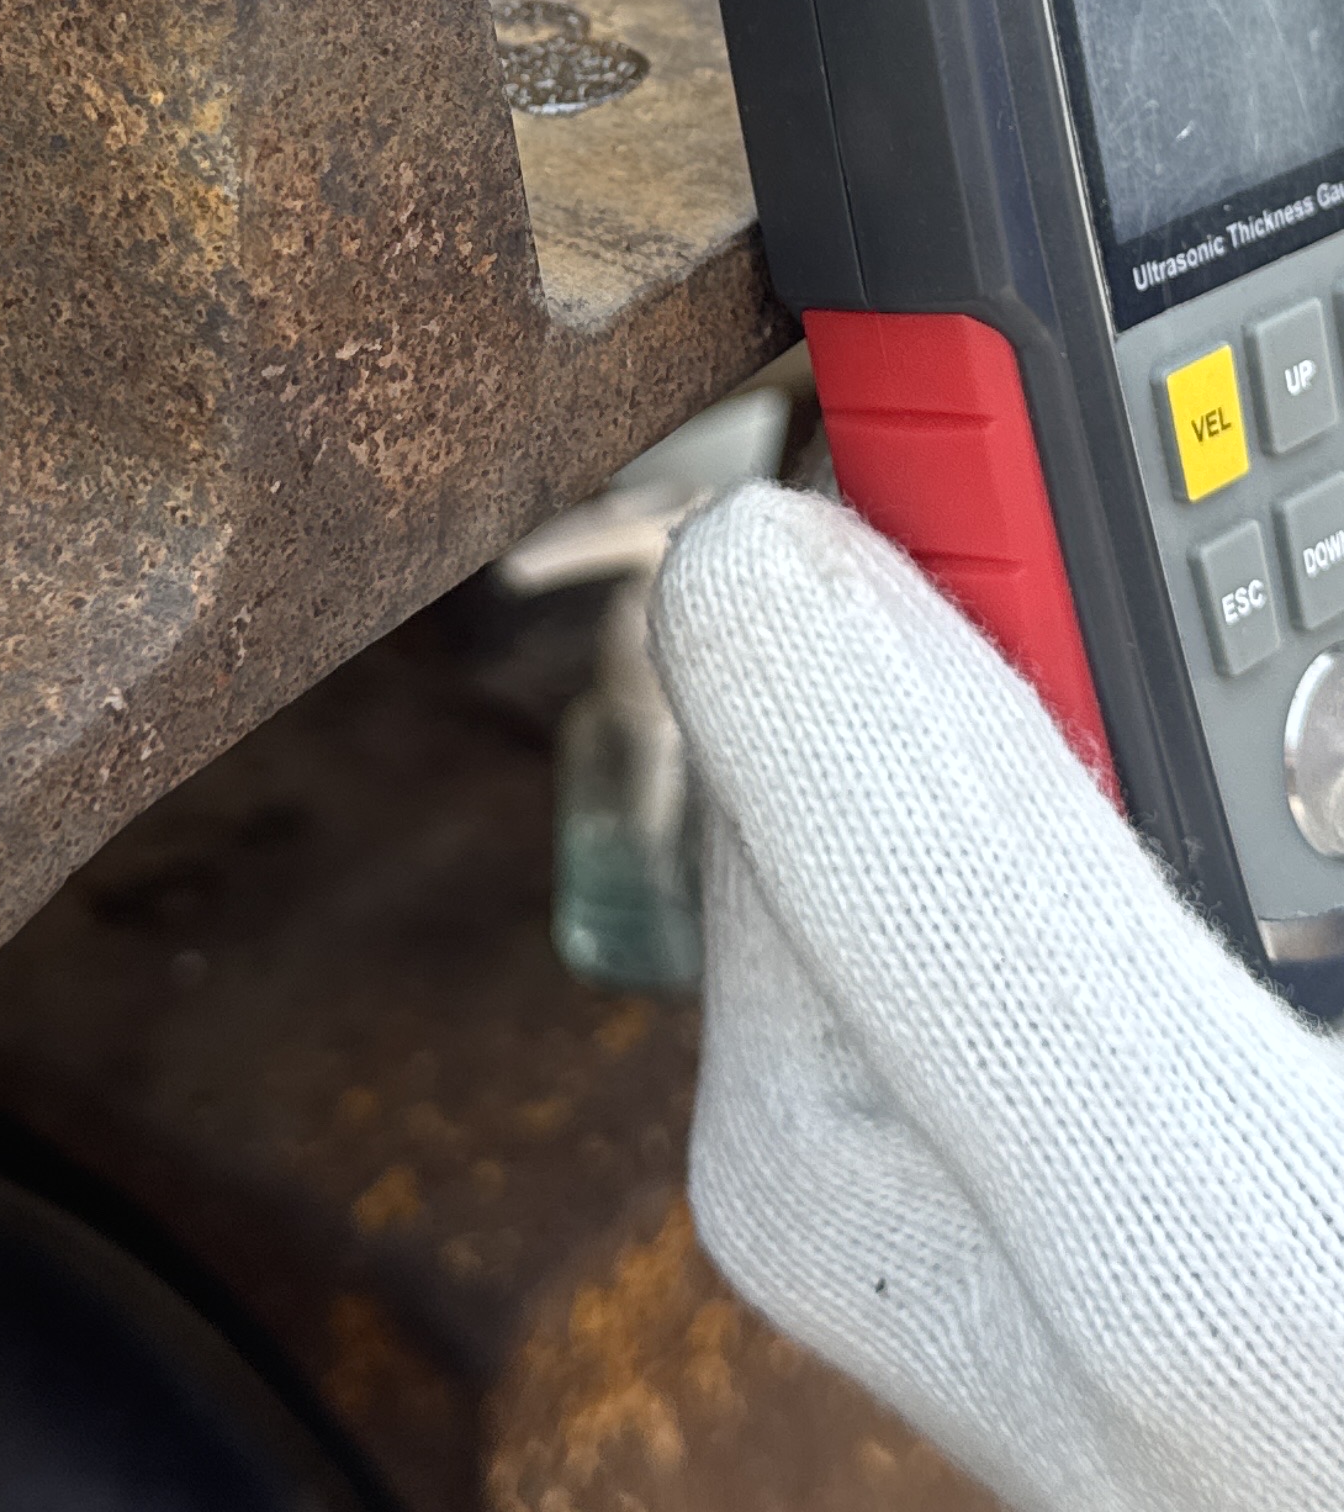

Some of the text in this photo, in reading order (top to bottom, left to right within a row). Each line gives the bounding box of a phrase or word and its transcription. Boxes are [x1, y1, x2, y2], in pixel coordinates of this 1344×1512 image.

[1133, 234, 1225, 291] Ultrasonic
[1226, 196, 1315, 249] Thickness
[1285, 360, 1317, 395] UP
[1191, 407, 1231, 442] VEL
[1222, 580, 1265, 625] ESC
